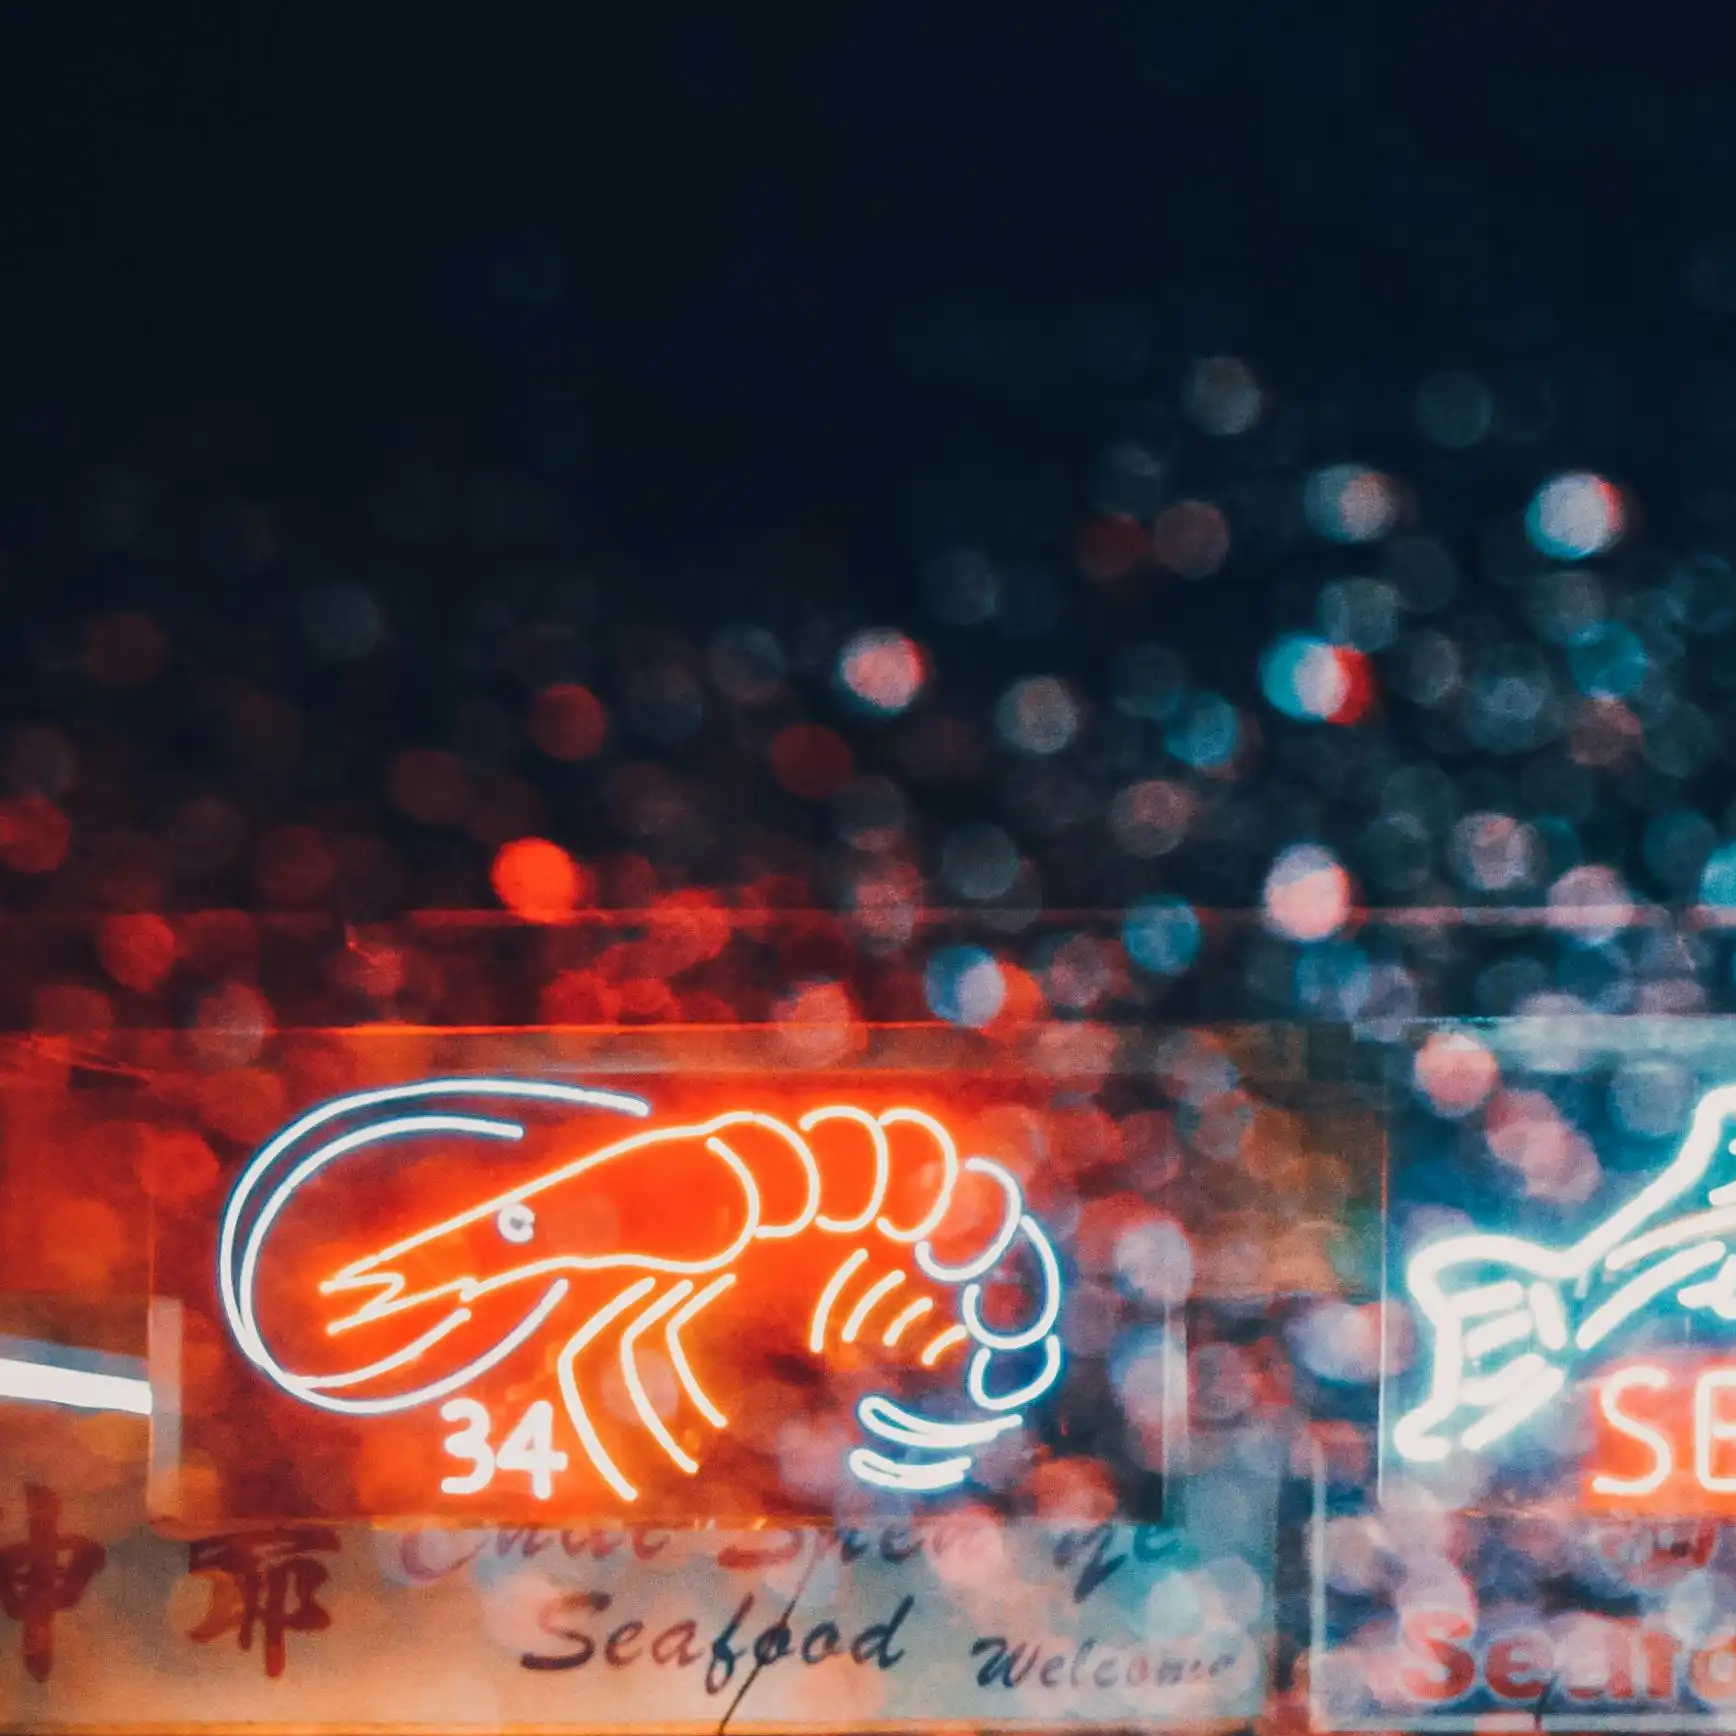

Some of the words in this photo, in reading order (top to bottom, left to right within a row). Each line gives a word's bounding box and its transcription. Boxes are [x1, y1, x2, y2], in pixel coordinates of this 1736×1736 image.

[440, 1398, 567, 1500] 34
[520, 1592, 915, 1695] Seafood
[969, 1635, 1237, 1689] Welcome
